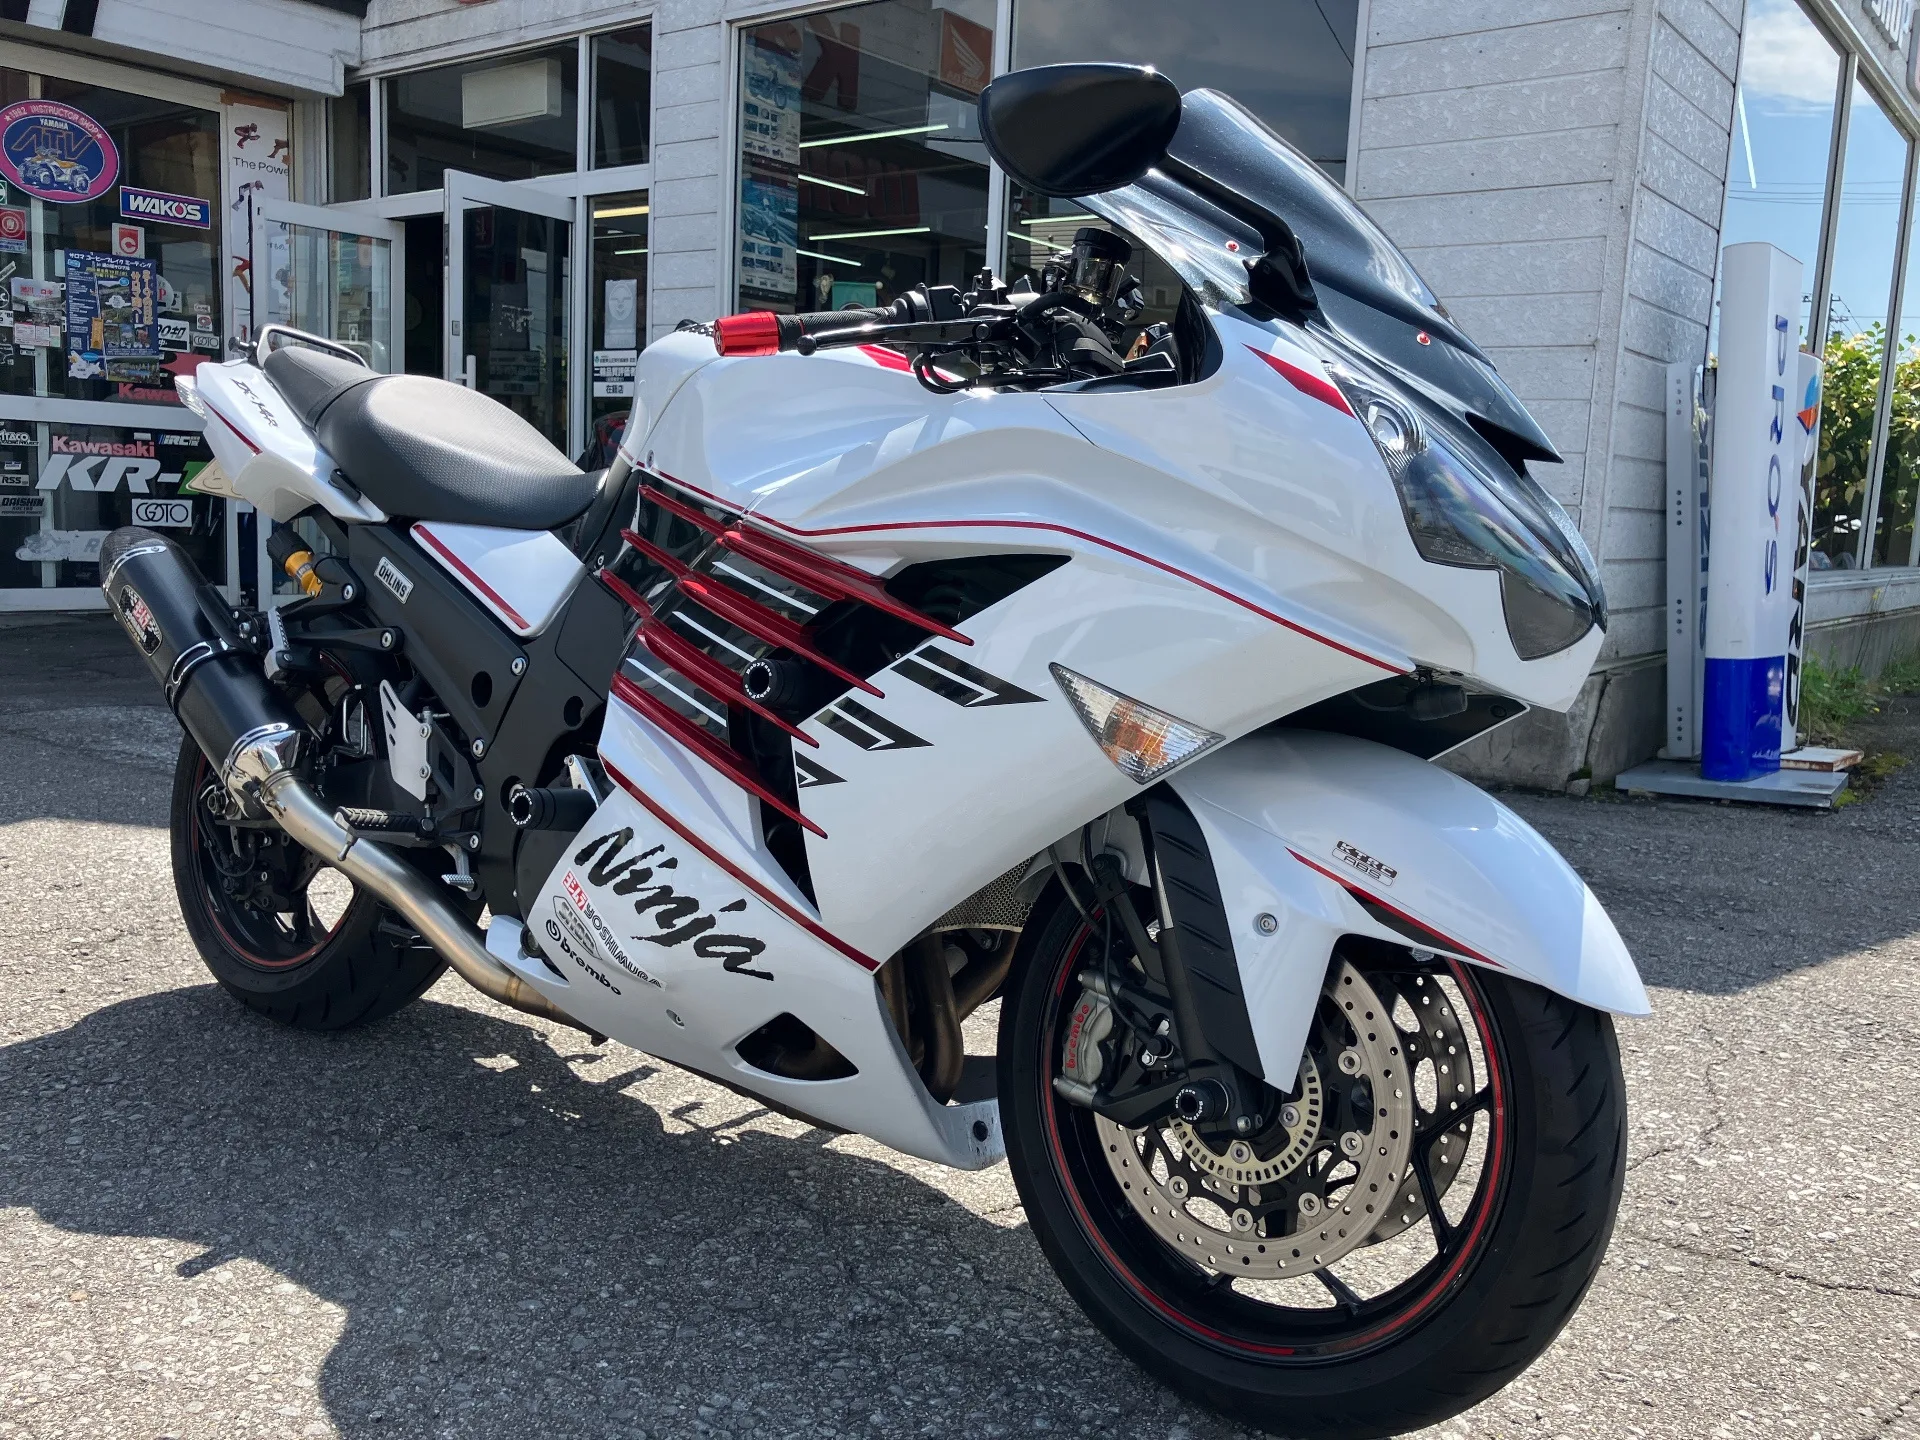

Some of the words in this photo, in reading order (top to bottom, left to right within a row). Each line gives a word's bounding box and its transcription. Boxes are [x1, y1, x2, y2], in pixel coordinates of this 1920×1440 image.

[40, 118, 69, 130] YAMAHA
[233, 157, 257, 170] The
[52, 435, 155, 458] Kawasaki
[2, 476, 21, 484] RSS
[1339, 842, 1396, 878] KTRC
[1344, 856, 1382, 880] ABS
[574, 826, 775, 982] Ninja
[584, 902, 662, 988] YOSHIMURA
[560, 937, 622, 996] brembo
[1066, 1004, 1090, 1069] brembo
